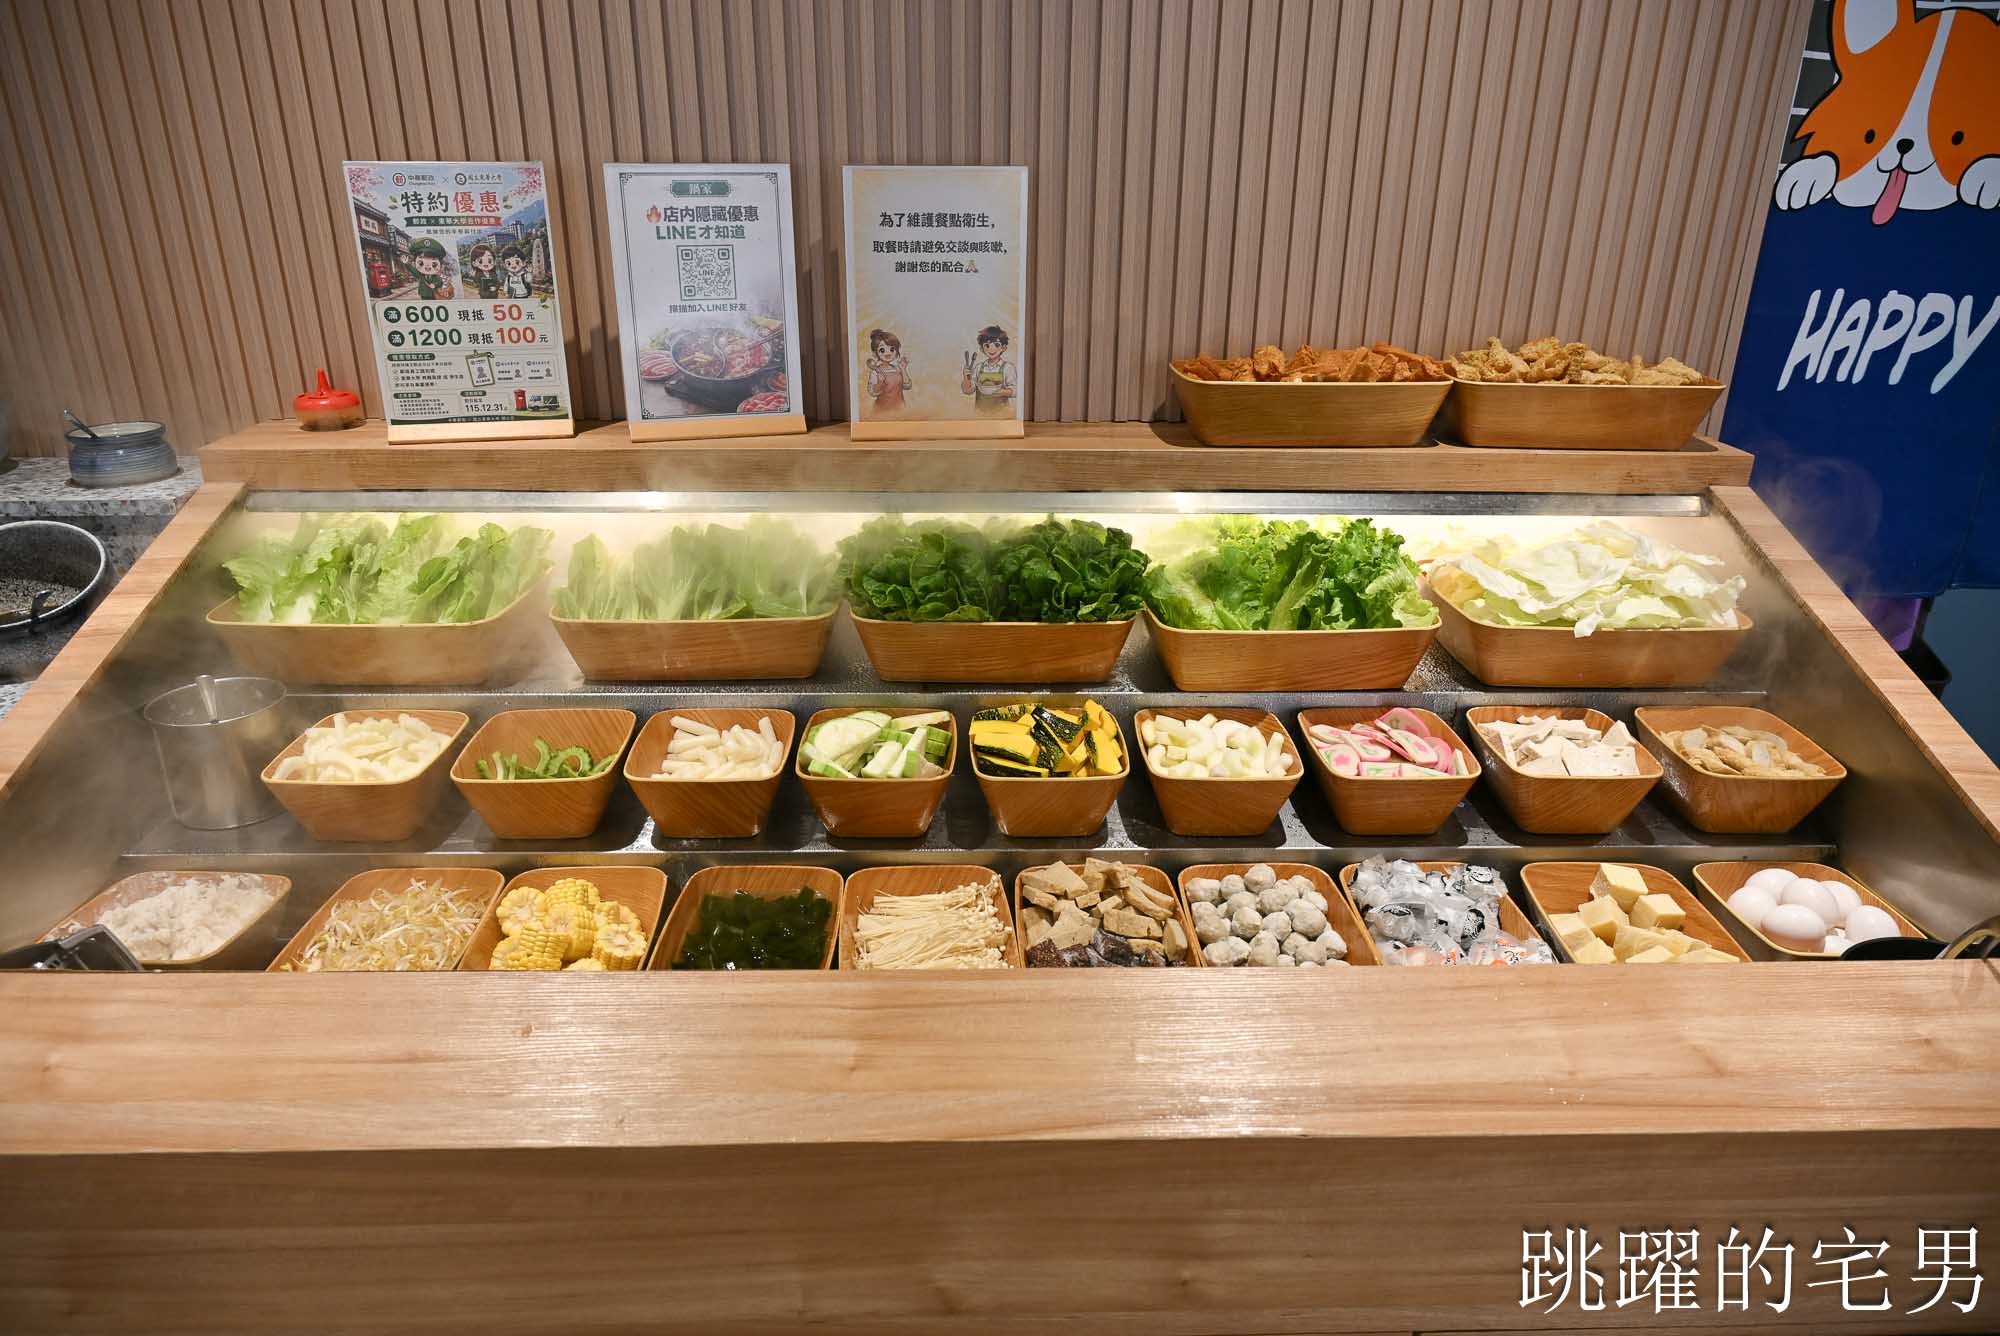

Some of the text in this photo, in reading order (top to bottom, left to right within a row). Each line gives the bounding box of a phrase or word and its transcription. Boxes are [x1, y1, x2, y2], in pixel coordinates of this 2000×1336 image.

[400, 190, 500, 214] 特約優惠
[663, 206, 760, 223] 店內隱藏優惠
[895, 261, 965, 273] 謝謝您的配合
[405, 305, 450, 323] 600
[457, 309, 485, 322] 現抵
[492, 303, 523, 322] 50
[525, 311, 536, 320] 元
[408, 328, 462, 347] 1200
[468, 333, 494, 345] 現抵
[496, 327, 536, 345] 100
[539, 334, 549, 343] 元
[1776, 288, 2000, 394] HAPPY
